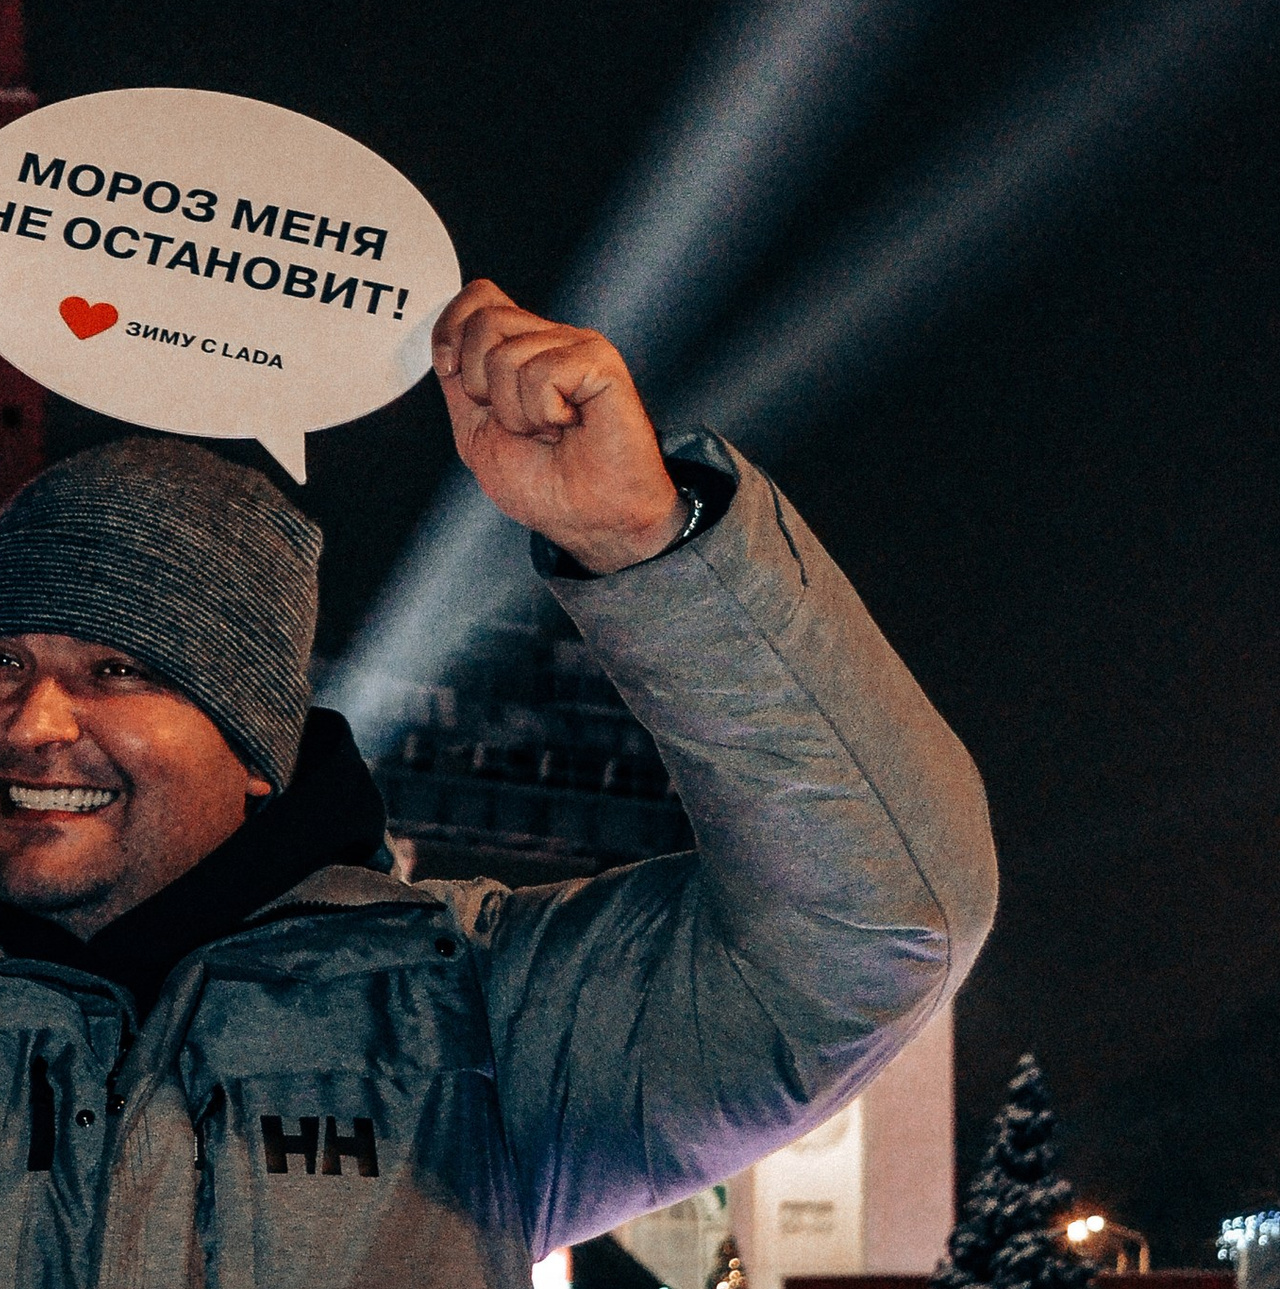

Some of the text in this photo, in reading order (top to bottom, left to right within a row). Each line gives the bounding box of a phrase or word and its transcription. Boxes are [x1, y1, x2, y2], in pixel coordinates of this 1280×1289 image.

[17, 152, 389, 261] МОРОЗ МЕНЯ
[63, 216, 410, 321] ОСТАНОВИТ!
[125, 321, 197, 348] ЗИМУ
[221, 342, 284, 370] LADA
[260, 1115, 380, 1178] HH
